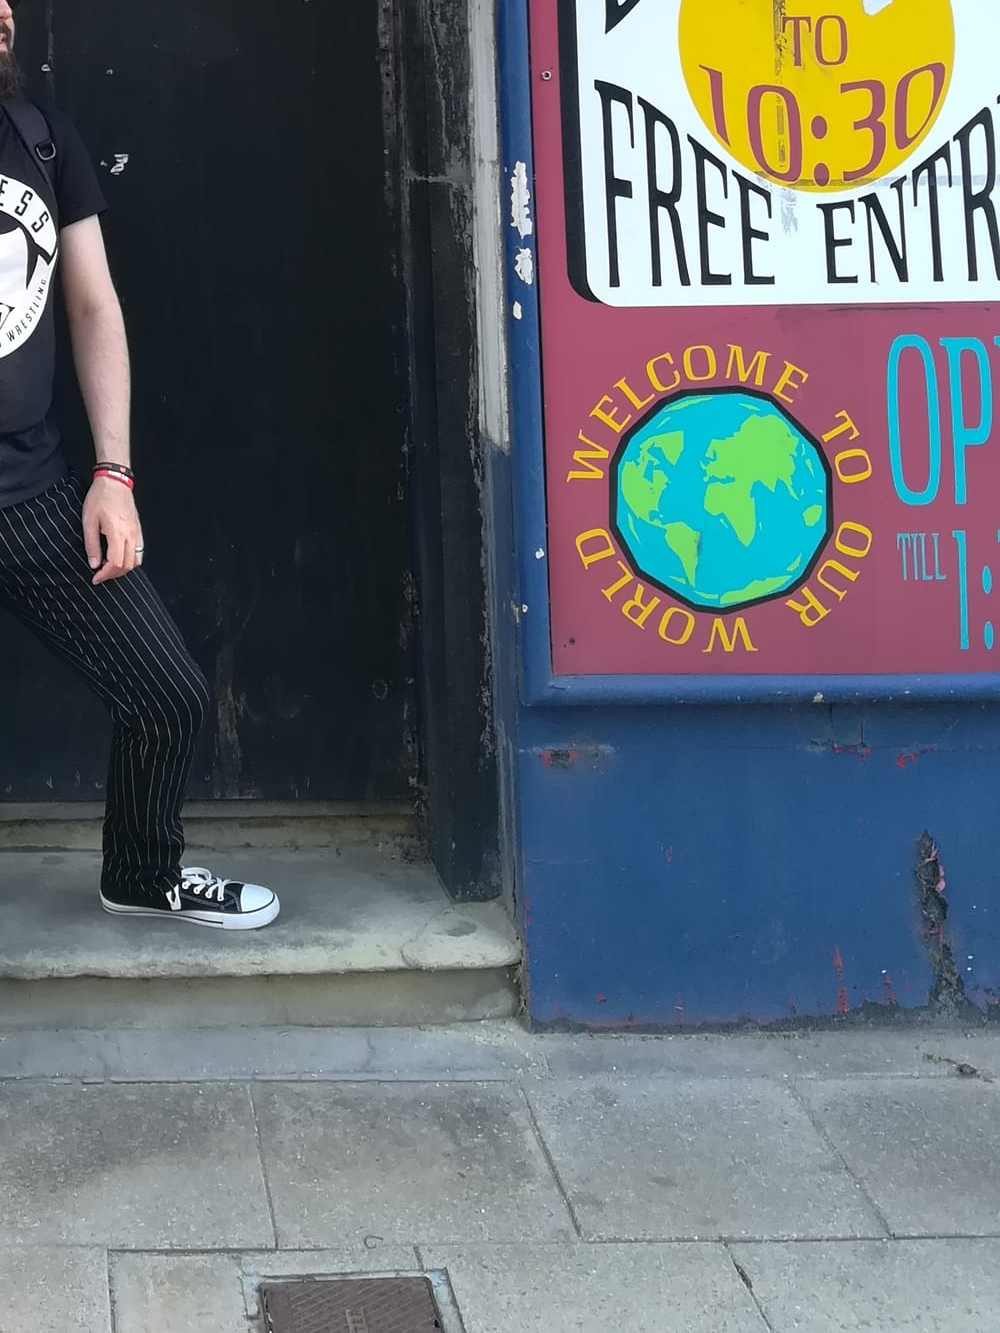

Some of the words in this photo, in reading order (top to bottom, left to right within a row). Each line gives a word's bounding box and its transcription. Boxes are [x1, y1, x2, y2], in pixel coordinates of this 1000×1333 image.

[782, 15, 848, 66] TO
[699, 62, 945, 186] 10:30
[594, 80, 775, 287] FREE
[816, 96, 1000, 283] ENTR
[6, 278, 47, 343] WRESTLING
[566, 344, 809, 483] WELCOME
[821, 410, 872, 483] TO
[887, 334, 1000, 505] OP
[574, 528, 758, 653] WORLD
[785, 521, 872, 627] OUR
[897, 533, 946, 580] TILL
